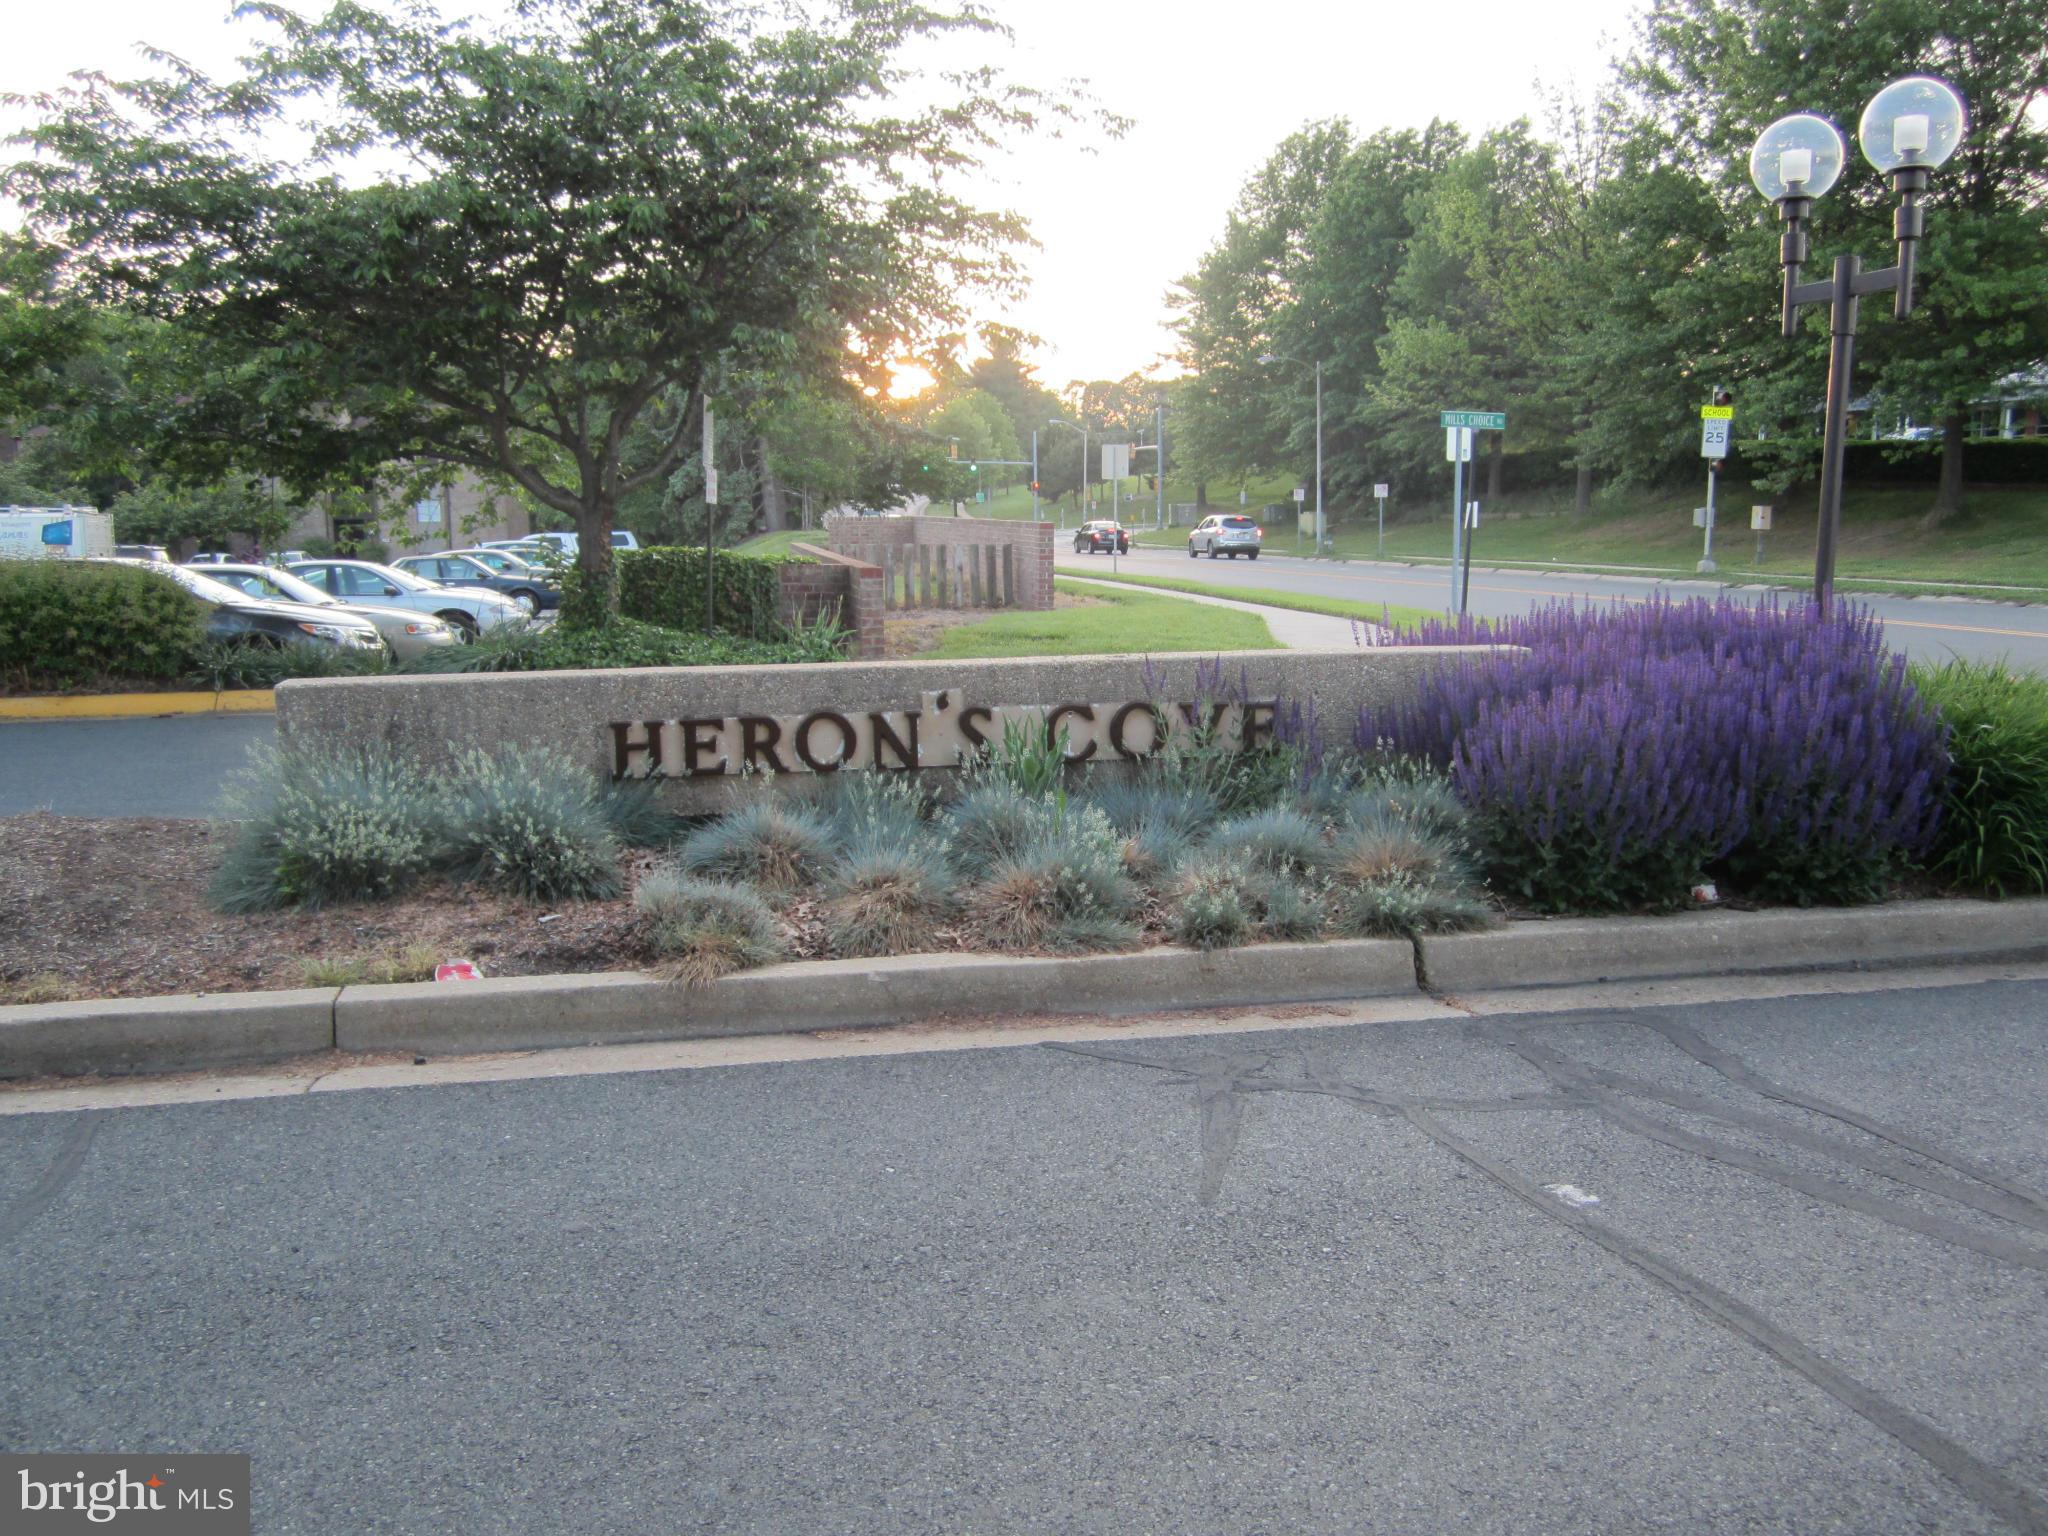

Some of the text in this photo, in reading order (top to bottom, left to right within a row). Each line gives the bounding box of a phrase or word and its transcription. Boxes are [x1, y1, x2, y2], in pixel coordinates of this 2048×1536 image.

[1703, 408, 1730, 416] SCHOOL
[1445, 414, 1465, 425] MILLS
[1468, 415, 1495, 426] CHOICE
[1705, 432, 1724, 444] 25
[609, 691, 997, 781] HERON'S
